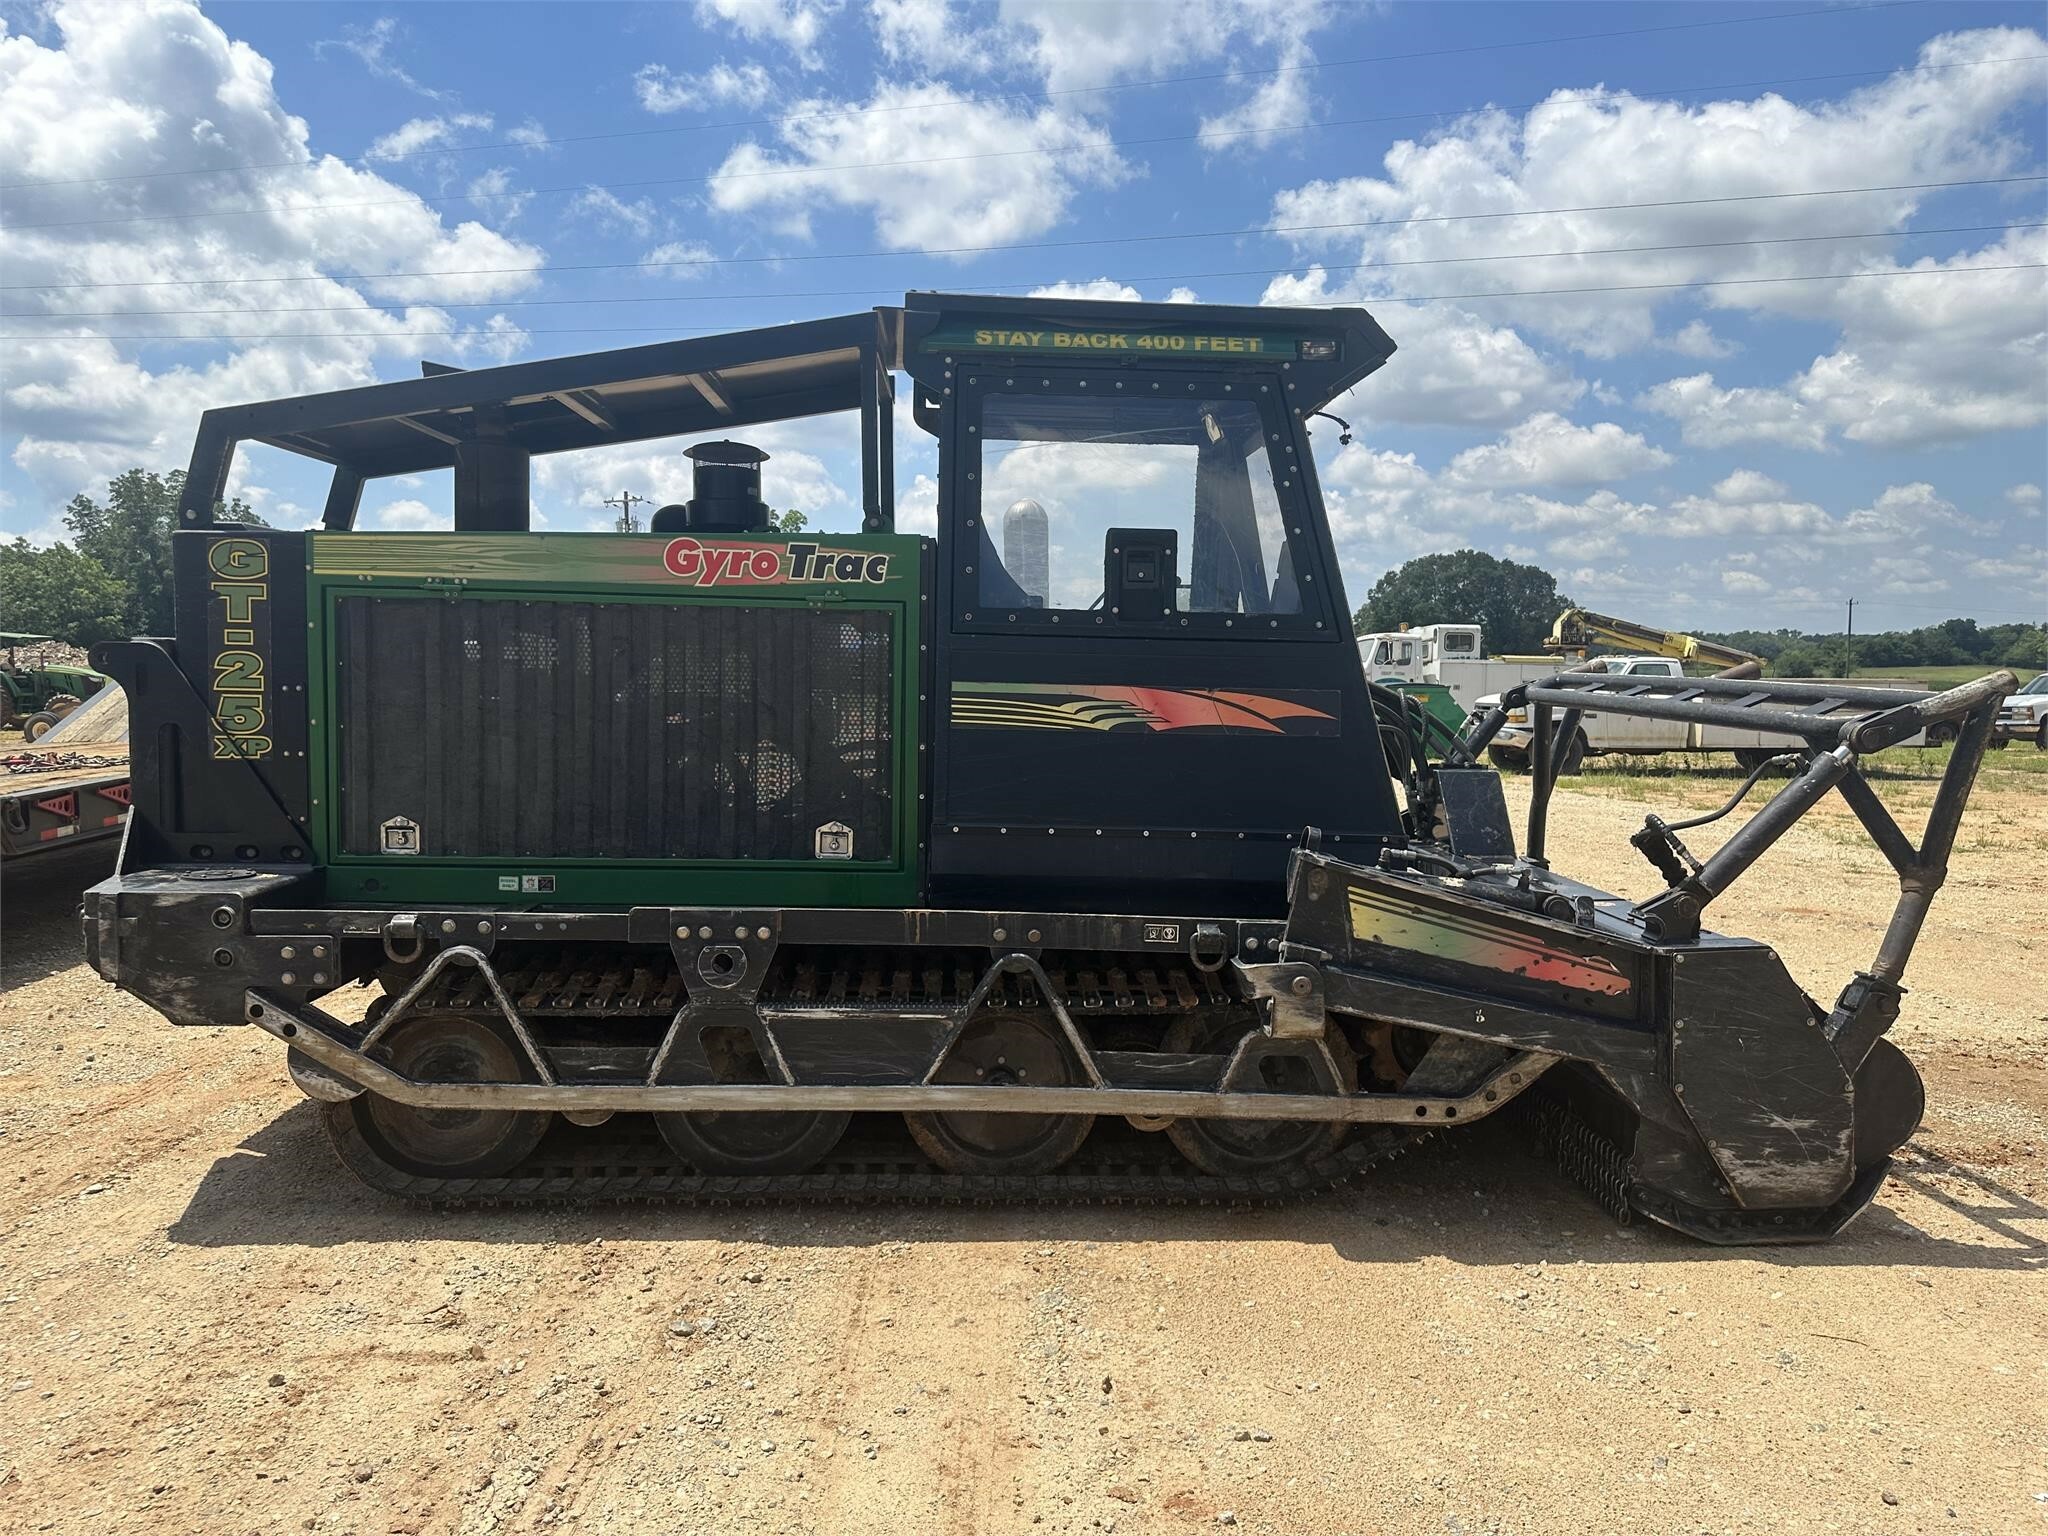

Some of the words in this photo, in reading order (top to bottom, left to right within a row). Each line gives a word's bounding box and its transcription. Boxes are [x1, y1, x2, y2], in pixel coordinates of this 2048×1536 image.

[975, 330, 1044, 347] STAY
[1053, 332, 1129, 349] BACK
[1136, 335, 1185, 351] 400
[1194, 337, 1262, 353] FEET
[663, 536, 780, 587] Gyro
[786, 542, 889, 584] Trac
[213, 735, 272, 759] XP
